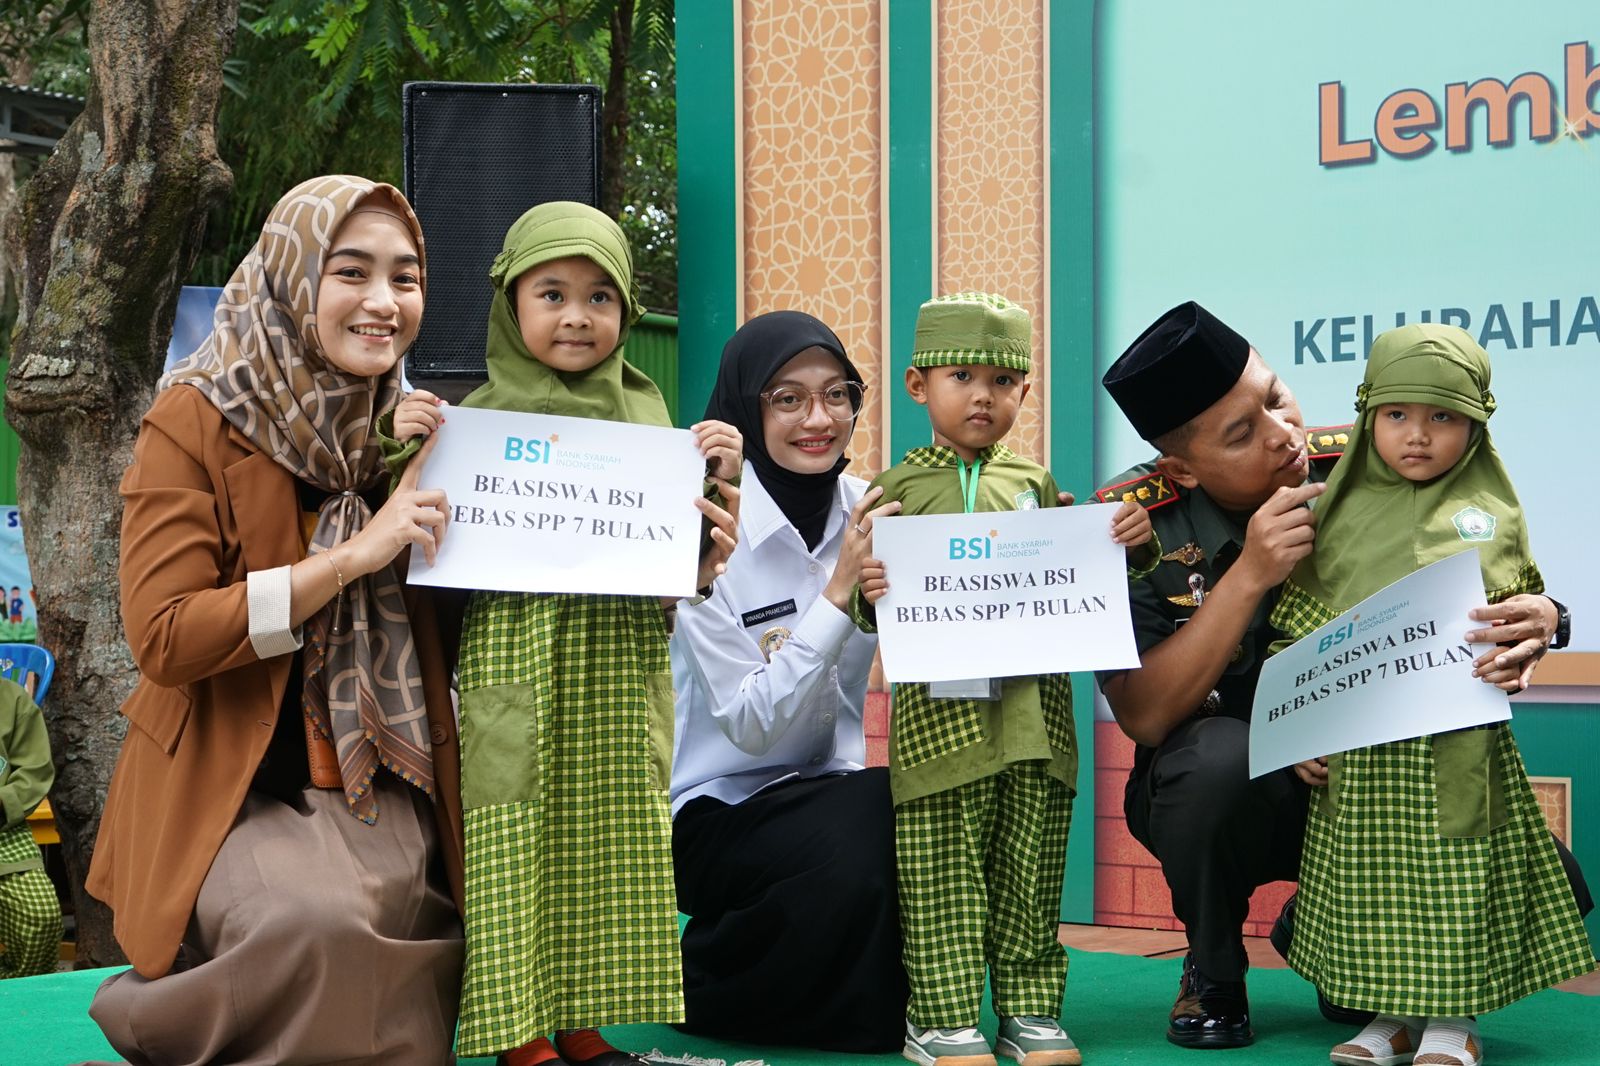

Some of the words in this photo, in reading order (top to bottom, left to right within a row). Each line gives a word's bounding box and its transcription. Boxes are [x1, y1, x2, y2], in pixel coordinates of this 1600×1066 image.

[1318, 41, 1600, 166] Lemb
[504, 436, 551, 464] BSI
[555, 458, 605, 470] INDONESIA
[556, 449, 581, 460] BANK
[583, 452, 622, 464] SYARIAH
[474, 474, 599, 503] BEASISWA
[608, 489, 644, 508] BSI
[449, 505, 516, 527] EBAS
[522, 512, 566, 531] SPP
[573, 517, 584, 533] 7
[591, 519, 675, 542] BULAN
[949, 537, 991, 560] BSI
[997, 542, 1019, 551] BANK
[1021, 539, 1053, 549] SYARIAH
[997, 548, 1040, 559] INDONESIA
[924, 572, 1037, 592] BEASISWA
[1044, 568, 1076, 586] BSI
[896, 605, 966, 623] BEBAS
[972, 603, 1010, 621] SPP
[1016, 602, 1026, 618] 7
[1033, 595, 1107, 617] BULAN
[1357, 614, 1378, 628] BANK
[1379, 600, 1410, 619] SYARIAH
[1357, 612, 1398, 635] INDONESIA
[1318, 622, 1353, 654] BSI
[1294, 635, 1397, 688] BEASISWA
[1403, 620, 1438, 643] BSI
[1267, 683, 1331, 723] BEBAS
[1336, 668, 1372, 693] SPP
[1378, 663, 1388, 680] 7
[1395, 643, 1475, 676] BULAN
